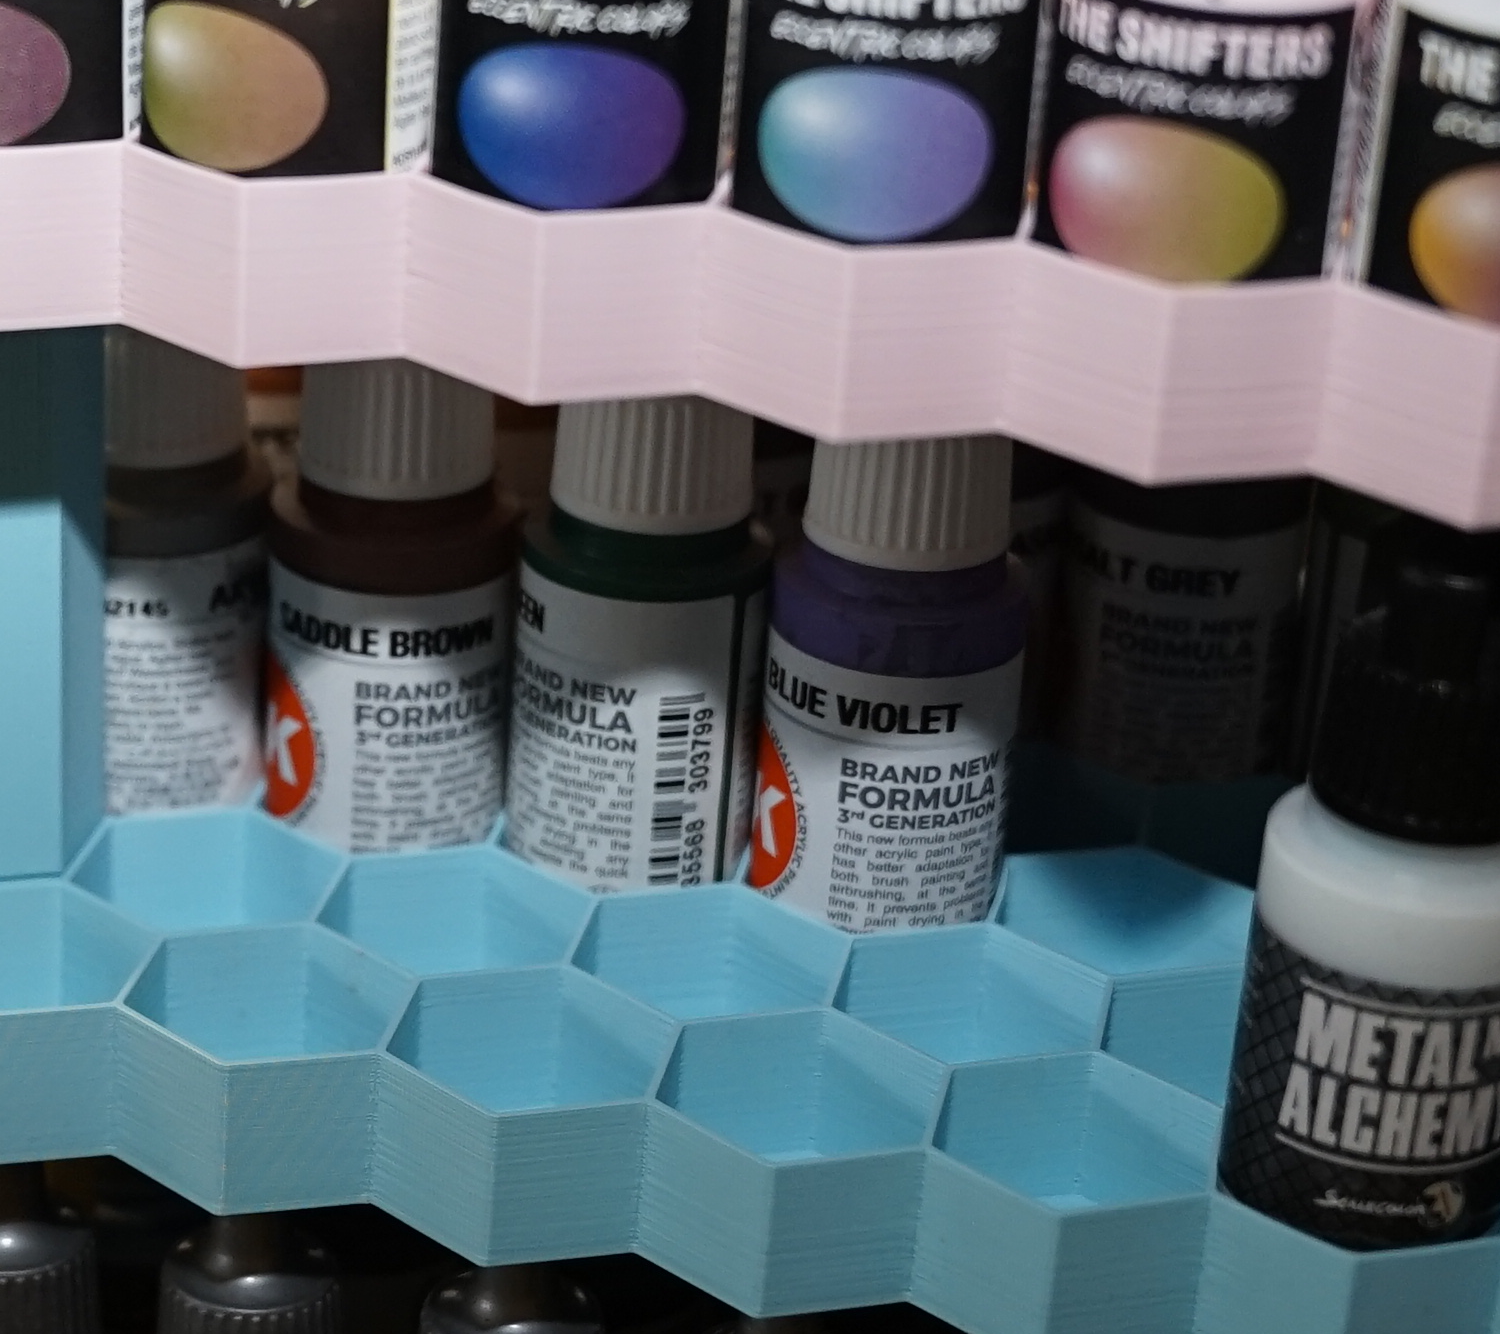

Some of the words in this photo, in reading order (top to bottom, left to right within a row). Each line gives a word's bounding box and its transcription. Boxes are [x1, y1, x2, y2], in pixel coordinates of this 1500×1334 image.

[1116, 22, 1335, 80] SHIFTERS
[1418, 29, 1498, 105] THE
[1145, 562, 1241, 597] GREY
[280, 601, 378, 657] SADDLE
[390, 615, 494, 658] BROWN
[1100, 624, 1256, 663] FORMULA
[356, 681, 451, 701] BRAND
[570, 678, 637, 706] NEW
[766, 657, 827, 719] BLUE
[836, 694, 964, 735] VIOLET
[354, 687, 500, 728] FORMULA
[688, 708, 714, 793] 303799
[612, 757, 636, 773] any
[840, 758, 941, 784] BRAND
[948, 749, 999, 782] NEW
[617, 784, 634, 797] for
[837, 775, 995, 811] FORMULA
[608, 799, 633, 811] and
[837, 807, 865, 823] 3rd
[869, 797, 996, 830] GENERATION
[610, 839, 630, 851] the
[836, 827, 863, 842] This
[867, 835, 893, 846] new
[899, 833, 946, 846] formula
[832, 854, 856, 868] has
[867, 861, 905, 873] better
[915, 854, 974, 872] adaptation
[833, 842, 867, 857] other
[875, 848, 918, 861] acrylic
[925, 846, 954, 861] paint
[830, 869, 859, 883] both
[872, 876, 909, 887] brush
[921, 870, 966, 887] painting
[829, 883, 905, 902] airbrushing,
[938, 886, 956, 896] the
[827, 910, 852, 923] with
[864, 915, 897, 928] paint
[908, 913, 945, 926] drying
[883, 902, 936, 915] prevents
[1294, 989, 1482, 1089] METAL
